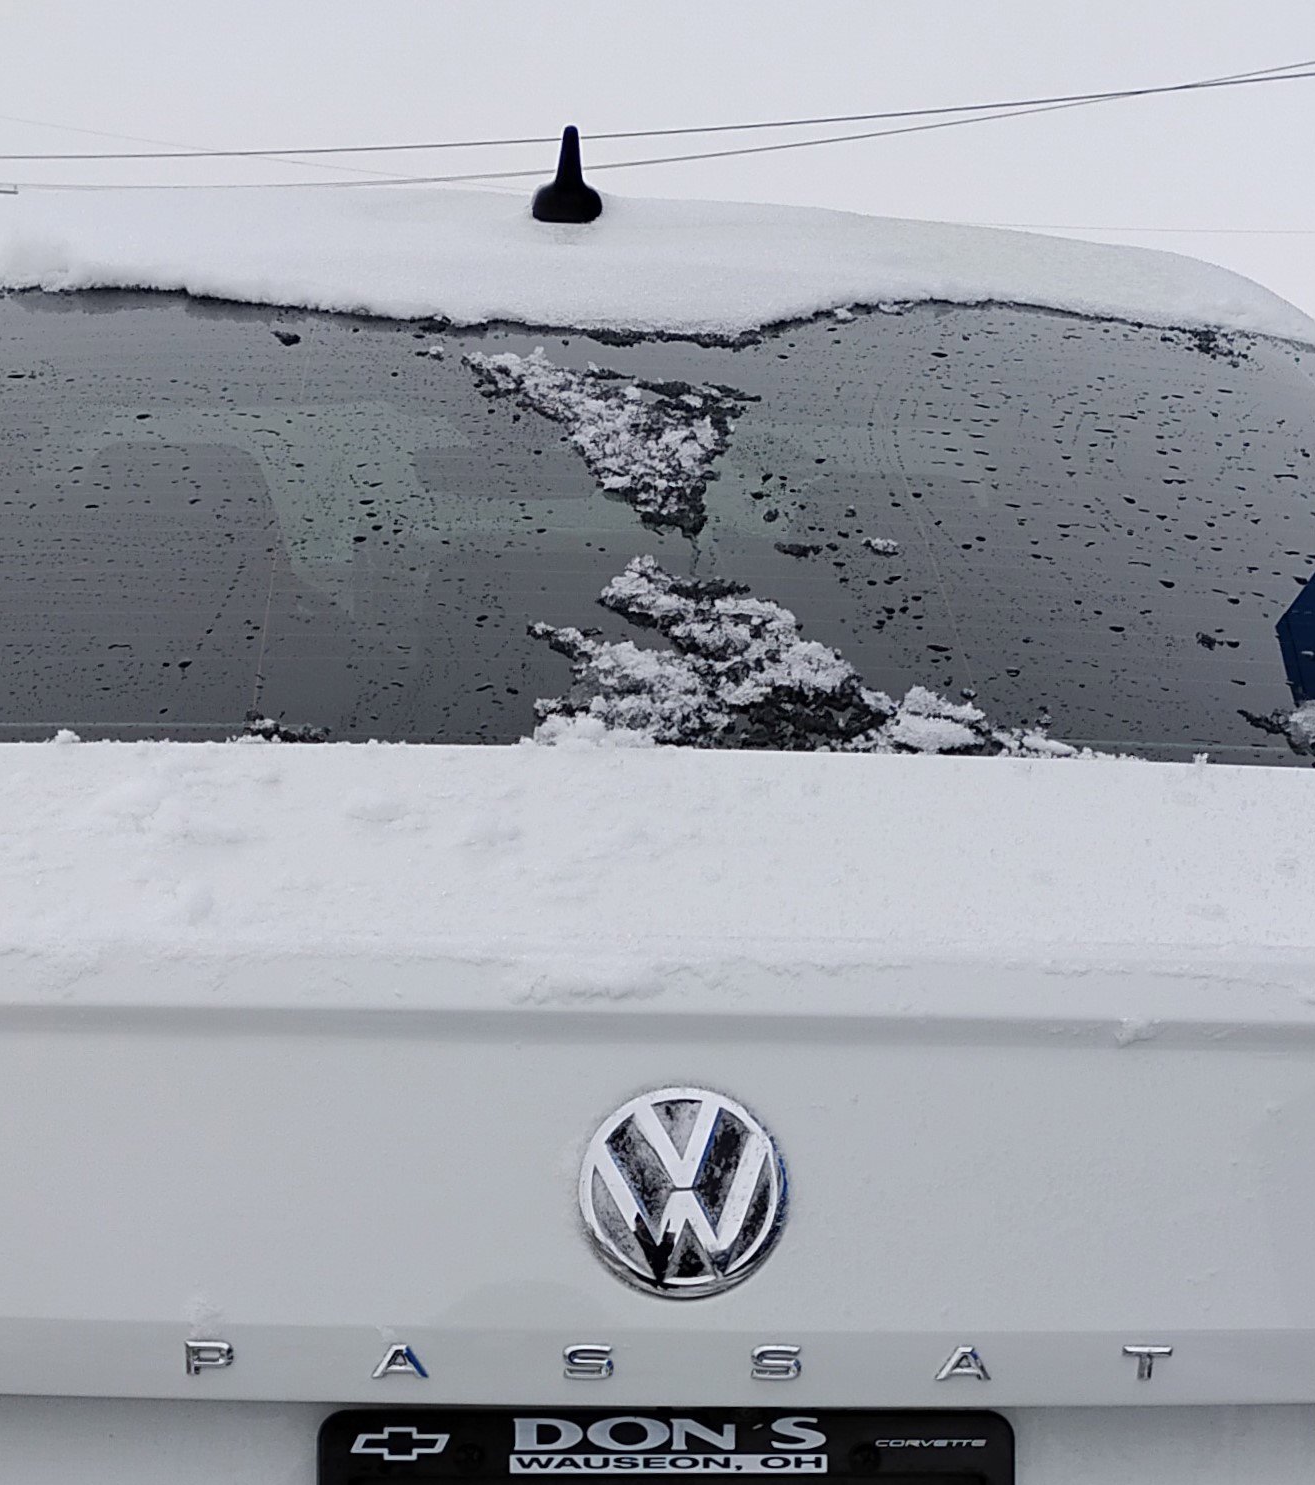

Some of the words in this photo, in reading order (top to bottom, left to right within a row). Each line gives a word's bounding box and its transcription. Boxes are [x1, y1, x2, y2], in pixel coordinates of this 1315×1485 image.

[184, 1338, 1174, 1383] PASSAT
[513, 1416, 827, 1451] DON'S
[875, 1439, 986, 1447] CORVETTE
[516, 1456, 743, 1471] WAUSEON,
[760, 1456, 823, 1469] OH
